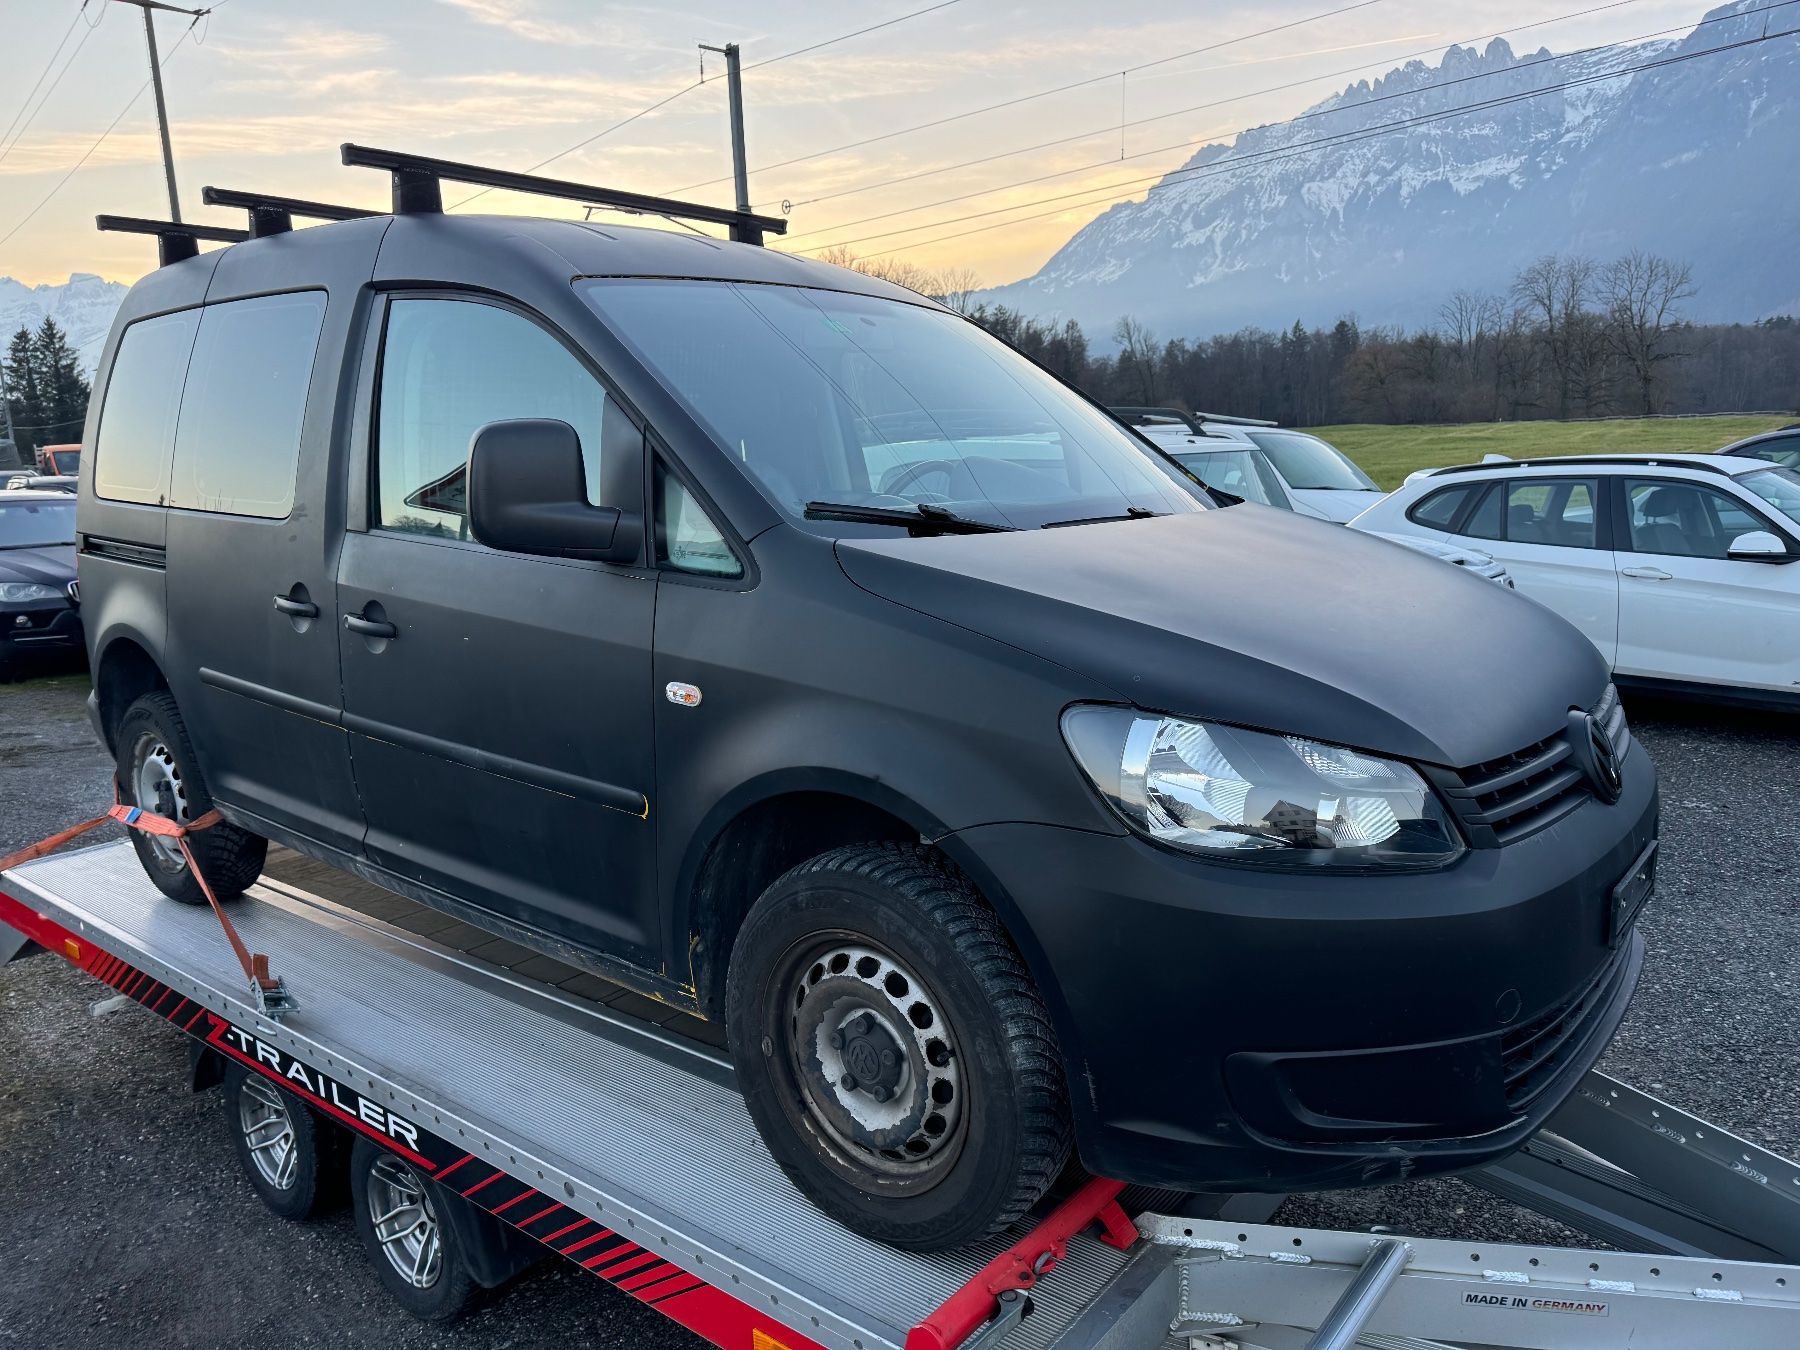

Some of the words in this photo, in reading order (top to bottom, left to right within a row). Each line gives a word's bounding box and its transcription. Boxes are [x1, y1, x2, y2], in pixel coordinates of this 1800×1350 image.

[206, 1012, 420, 1152] Z-TRAILER
[1465, 1294, 1509, 1306] MADE
[1511, 1297, 1528, 1308] IN
[1532, 1299, 1606, 1314] GERMANY
